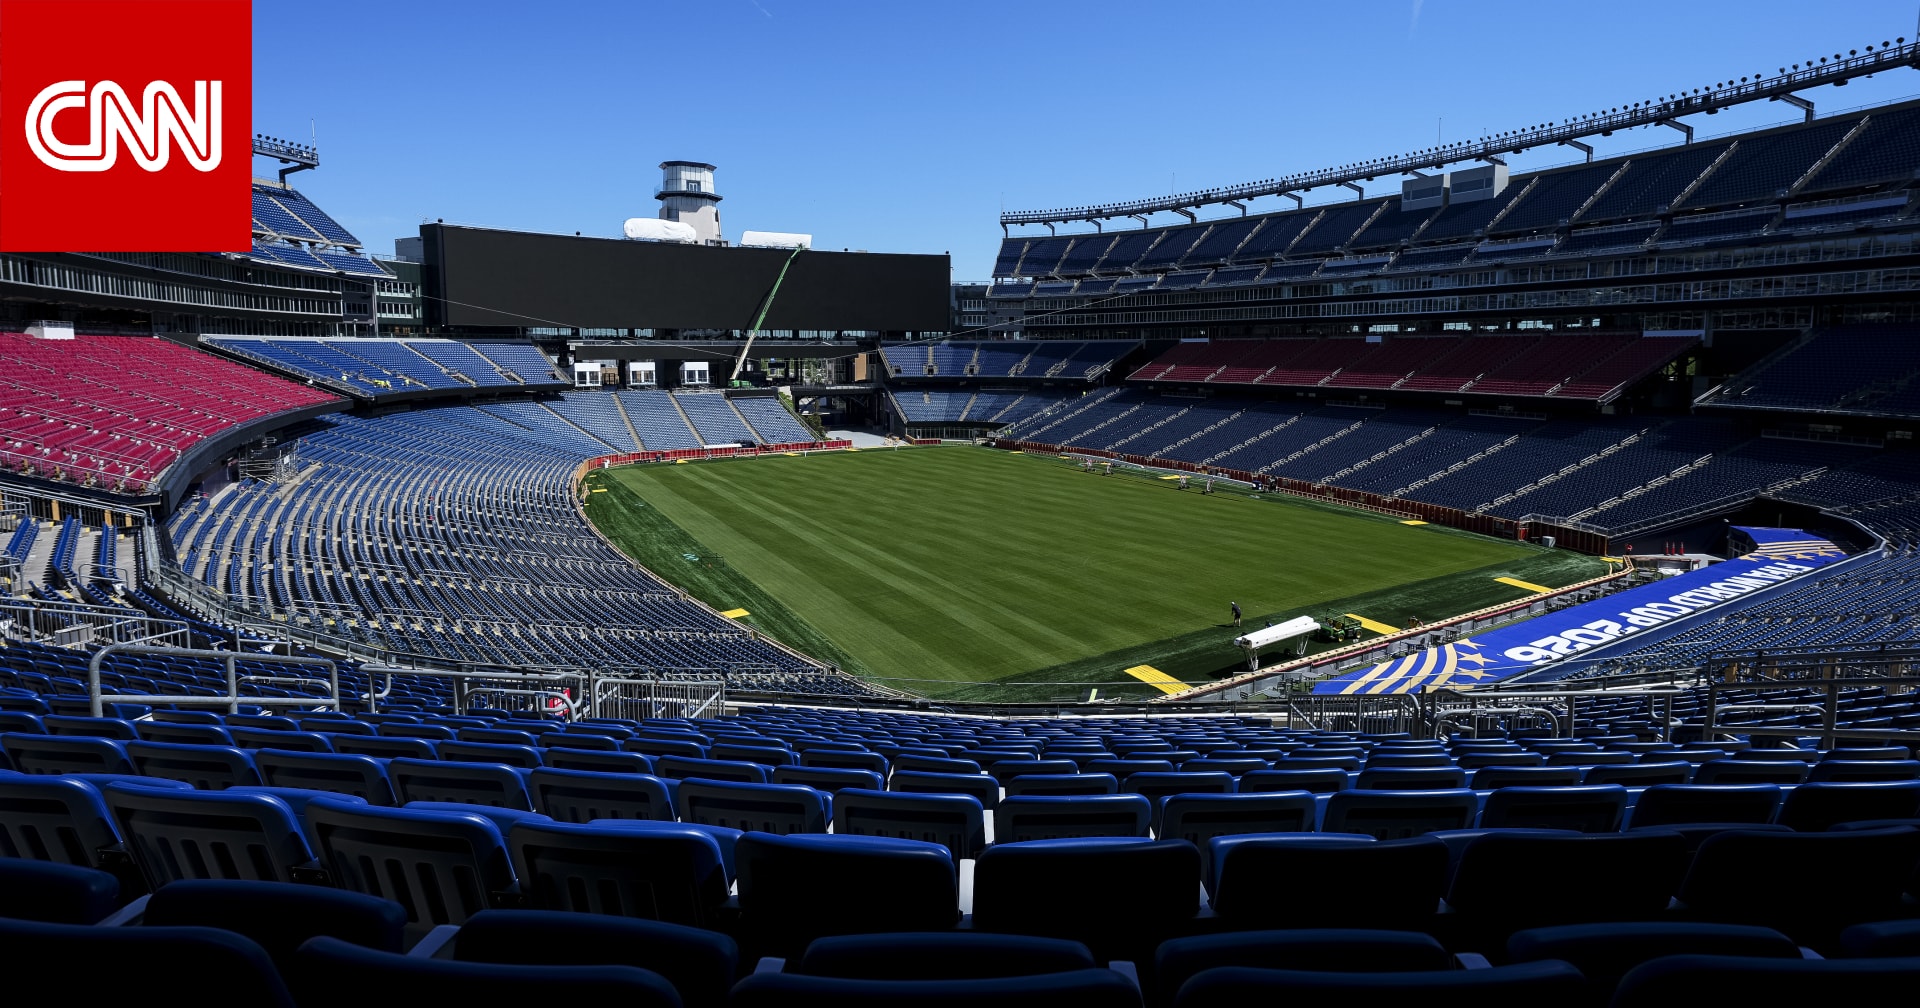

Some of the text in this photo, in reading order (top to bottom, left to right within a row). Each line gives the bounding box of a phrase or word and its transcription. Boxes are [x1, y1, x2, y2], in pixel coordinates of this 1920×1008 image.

[1503, 562, 1815, 666] FIFA WORLD CUP 2026
